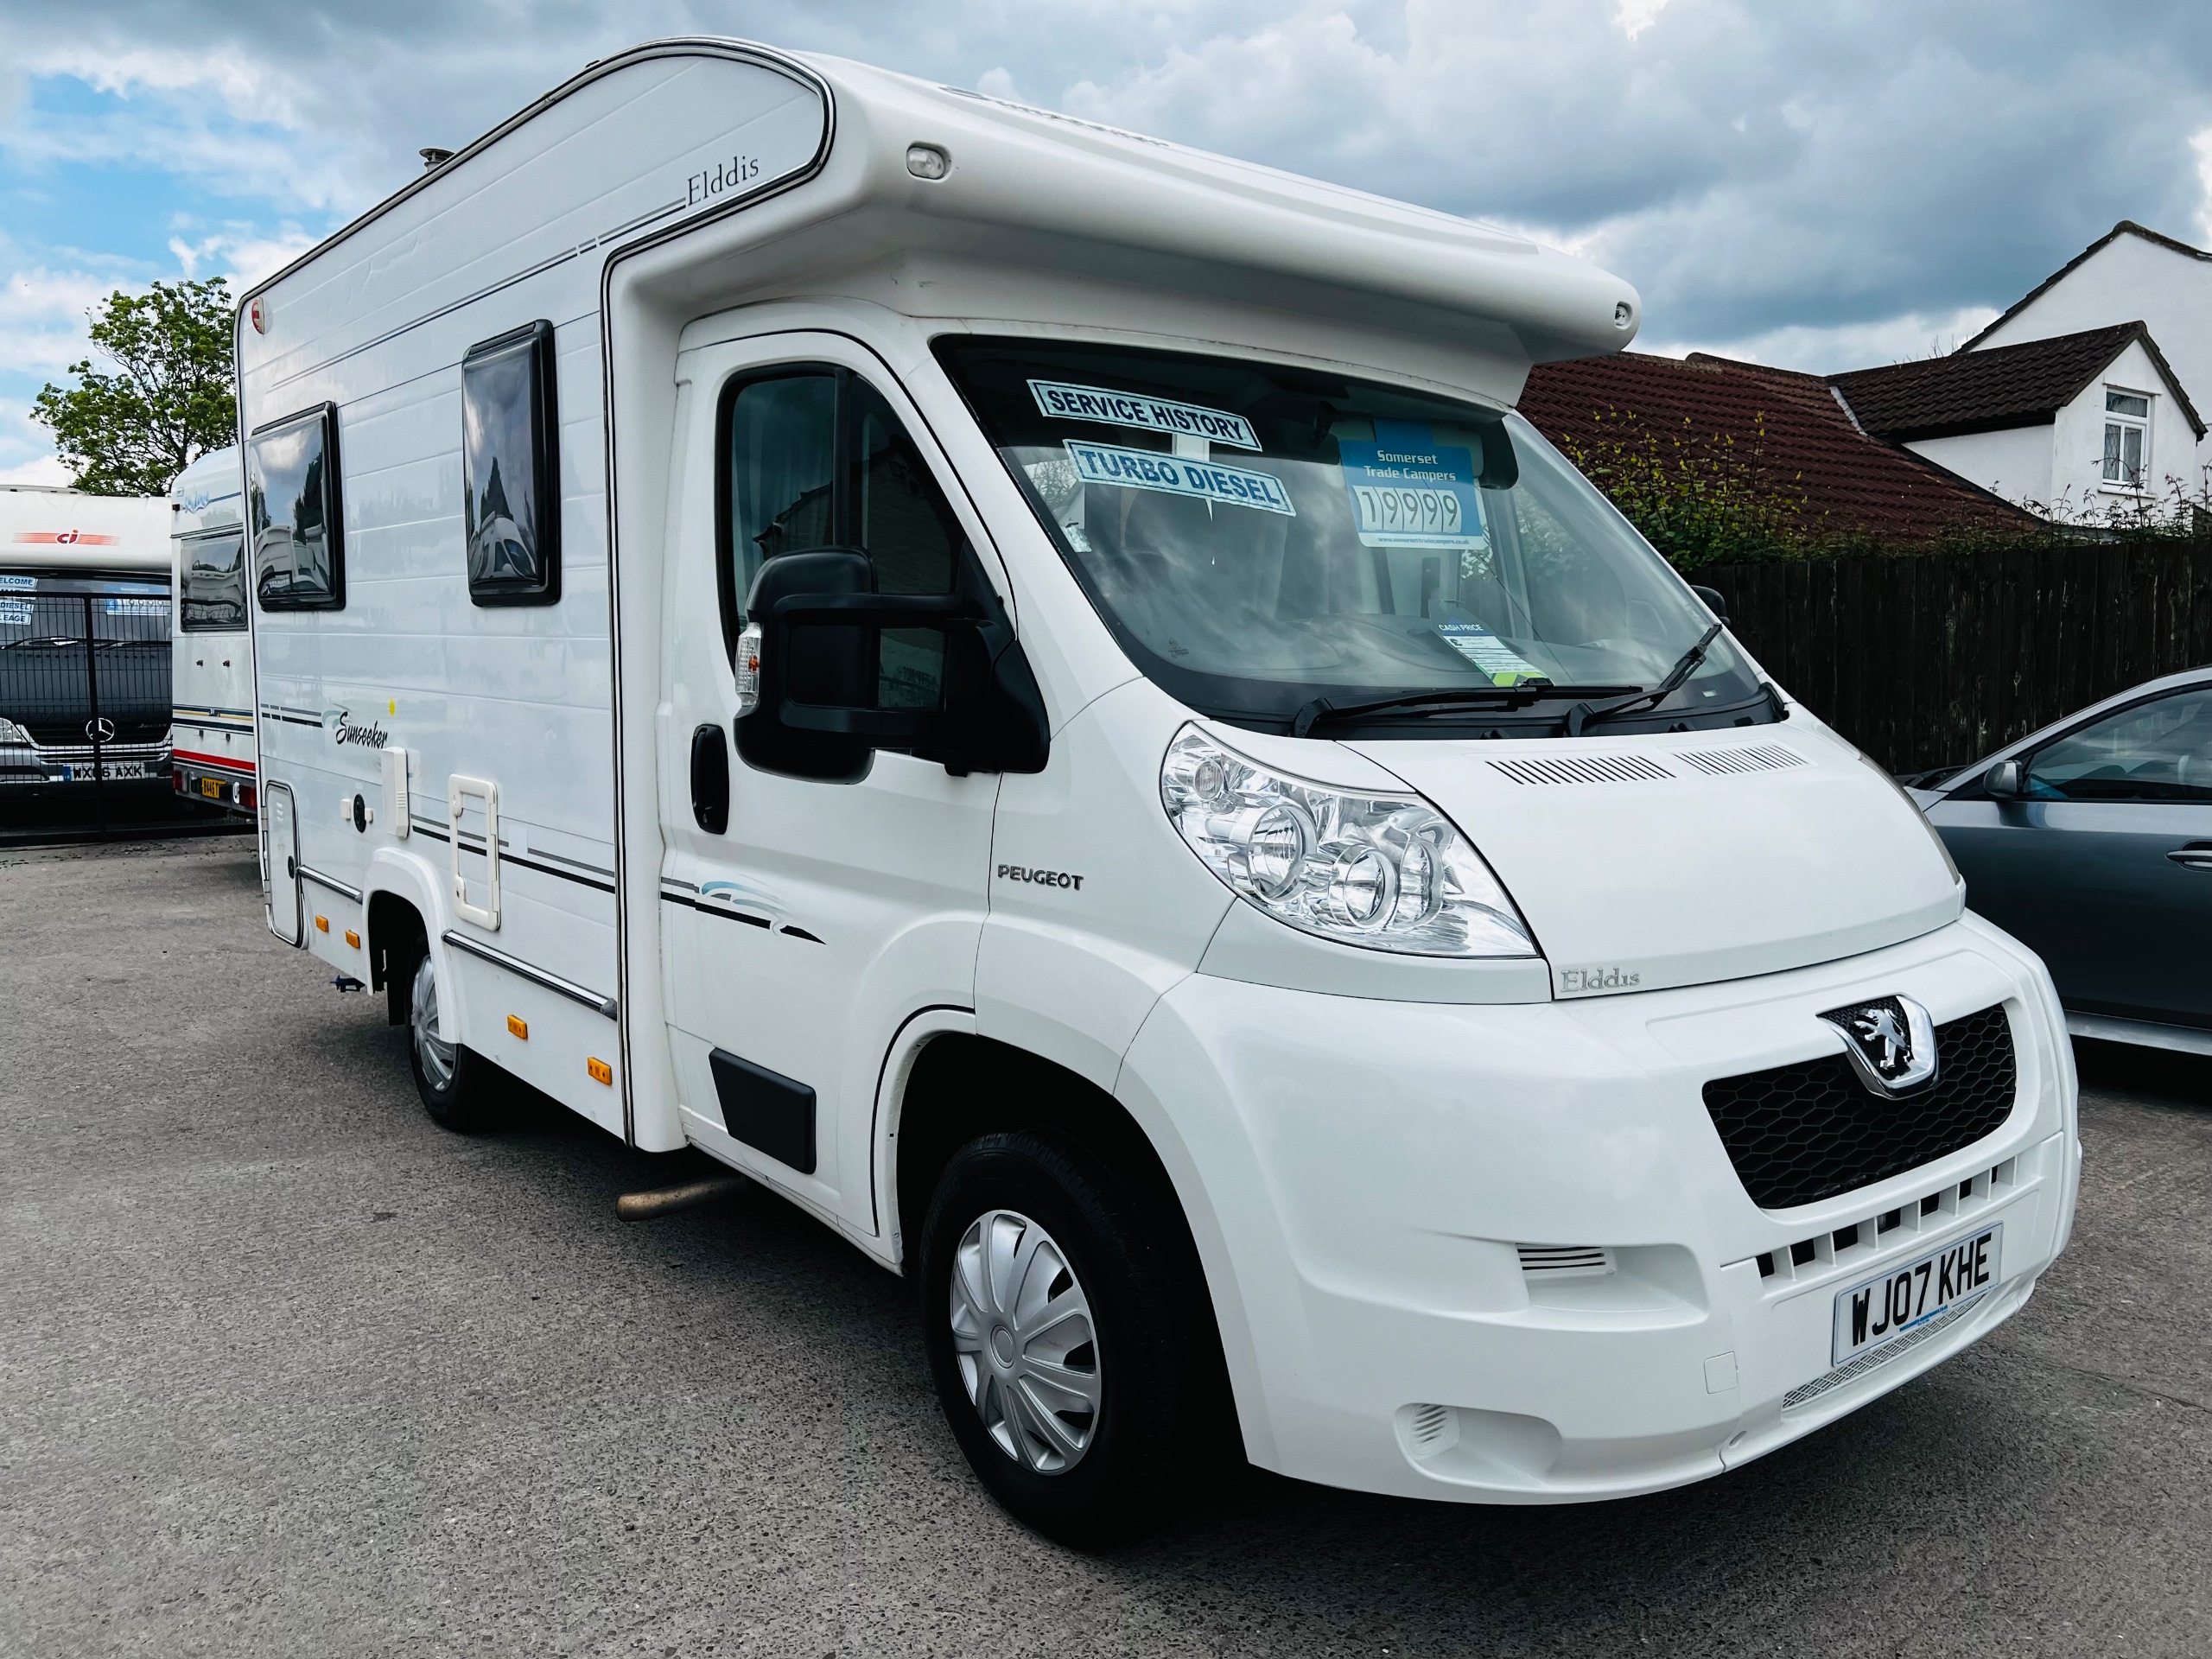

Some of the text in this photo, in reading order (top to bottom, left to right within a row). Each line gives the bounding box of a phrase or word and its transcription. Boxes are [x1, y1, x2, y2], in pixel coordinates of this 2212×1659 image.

[688, 156, 759, 206] Elddis
[1046, 390, 1243, 441] SERVICE HISTORY
[1377, 450, 1438, 464] Somerset
[1077, 450, 1281, 505] TURBO DIESEL
[1363, 465, 1456, 482] Trade Campers
[1362, 491, 1458, 527] 19999
[0, 577, 34, 586] ELCOME
[336, 711, 388, 749] Sunseeker
[73, 766, 143, 778] WX6 AXK
[997, 864, 1084, 890] PEUGEOT
[1560, 966, 1640, 993] Elddis
[1852, 1232, 1993, 1346] WJ07 KHE
